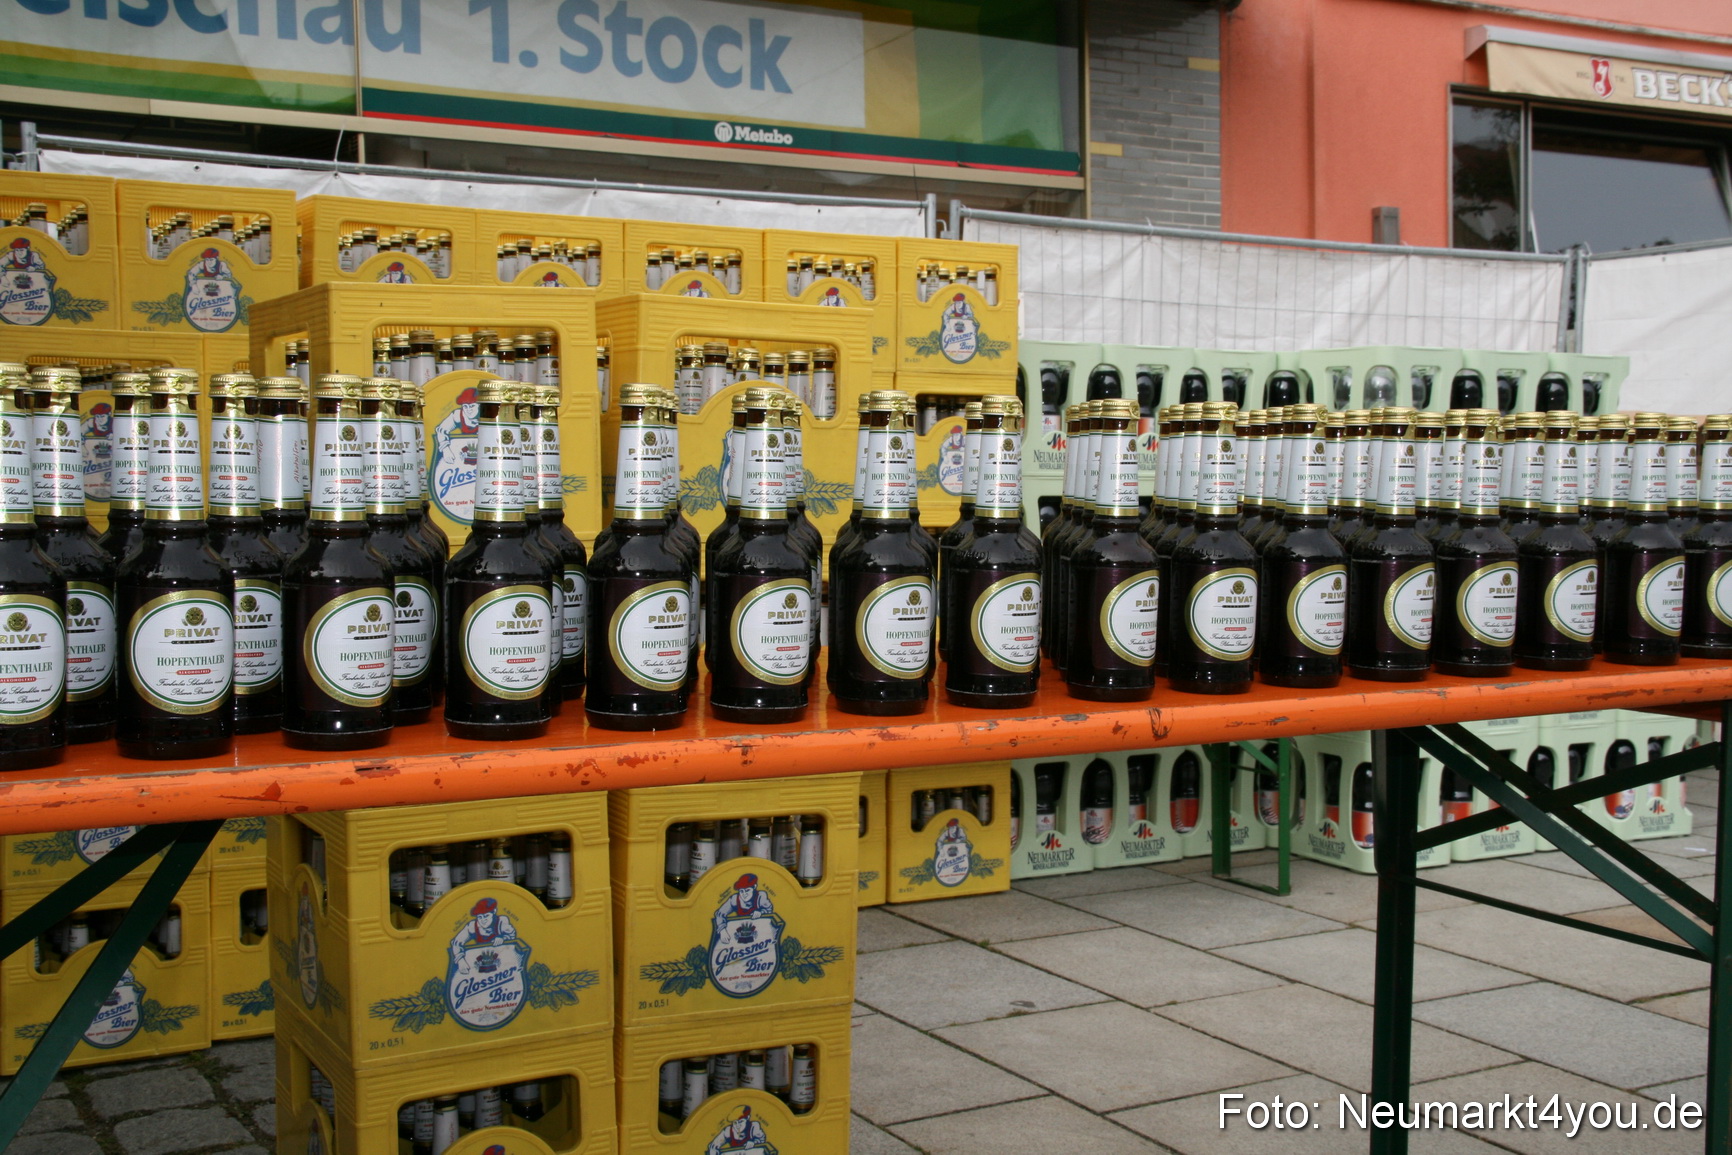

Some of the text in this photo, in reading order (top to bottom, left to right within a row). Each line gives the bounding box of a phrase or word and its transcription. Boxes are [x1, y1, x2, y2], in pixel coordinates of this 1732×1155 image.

[468, 0, 538, 68] 1.
[557, 0, 792, 94] Stock
[735, 126, 793, 144] Metabo
[25, 301, 49, 312] Bier
[213, 308, 235, 319] Bier
[36, 437, 81, 448] PRIVAT
[154, 439, 199, 450] PRIVAT
[213, 440, 255, 451] PRIVAT
[150, 464, 202, 476] HOPFENTHALER
[1217, 595, 1253, 605] PRIVAT
[768, 609, 807, 620] PRIVAT
[892, 606, 929, 616] PRIVAT
[496, 618, 543, 630] PRIVAT
[648, 613, 687, 625] PRIVAT
[164, 627, 220, 639] PRIVAT
[348, 622, 391, 635] PRIVAT
[489, 644, 546, 657] HOPFENTHALER
[157, 654, 225, 667] HOPFENTHALER
[1120, 837, 1165, 853] NEUMARKTER
[1027, 848, 1075, 864] NEUMARKTER
[746, 958, 774, 973] Bier
[729, 974, 740, 982] gute
[741, 971, 770, 980] Neumarkter
[489, 987, 522, 1005] Bier
[472, 1006, 484, 1015] gute
[484, 1000, 519, 1012] Neumarkter
[638, 1001, 648, 1010] 20
[654, 1000, 665, 1009] 0,5
[112, 1016, 137, 1029] Bier
[369, 1041, 380, 1050] 20
[387, 1038, 401, 1049] 0,5
